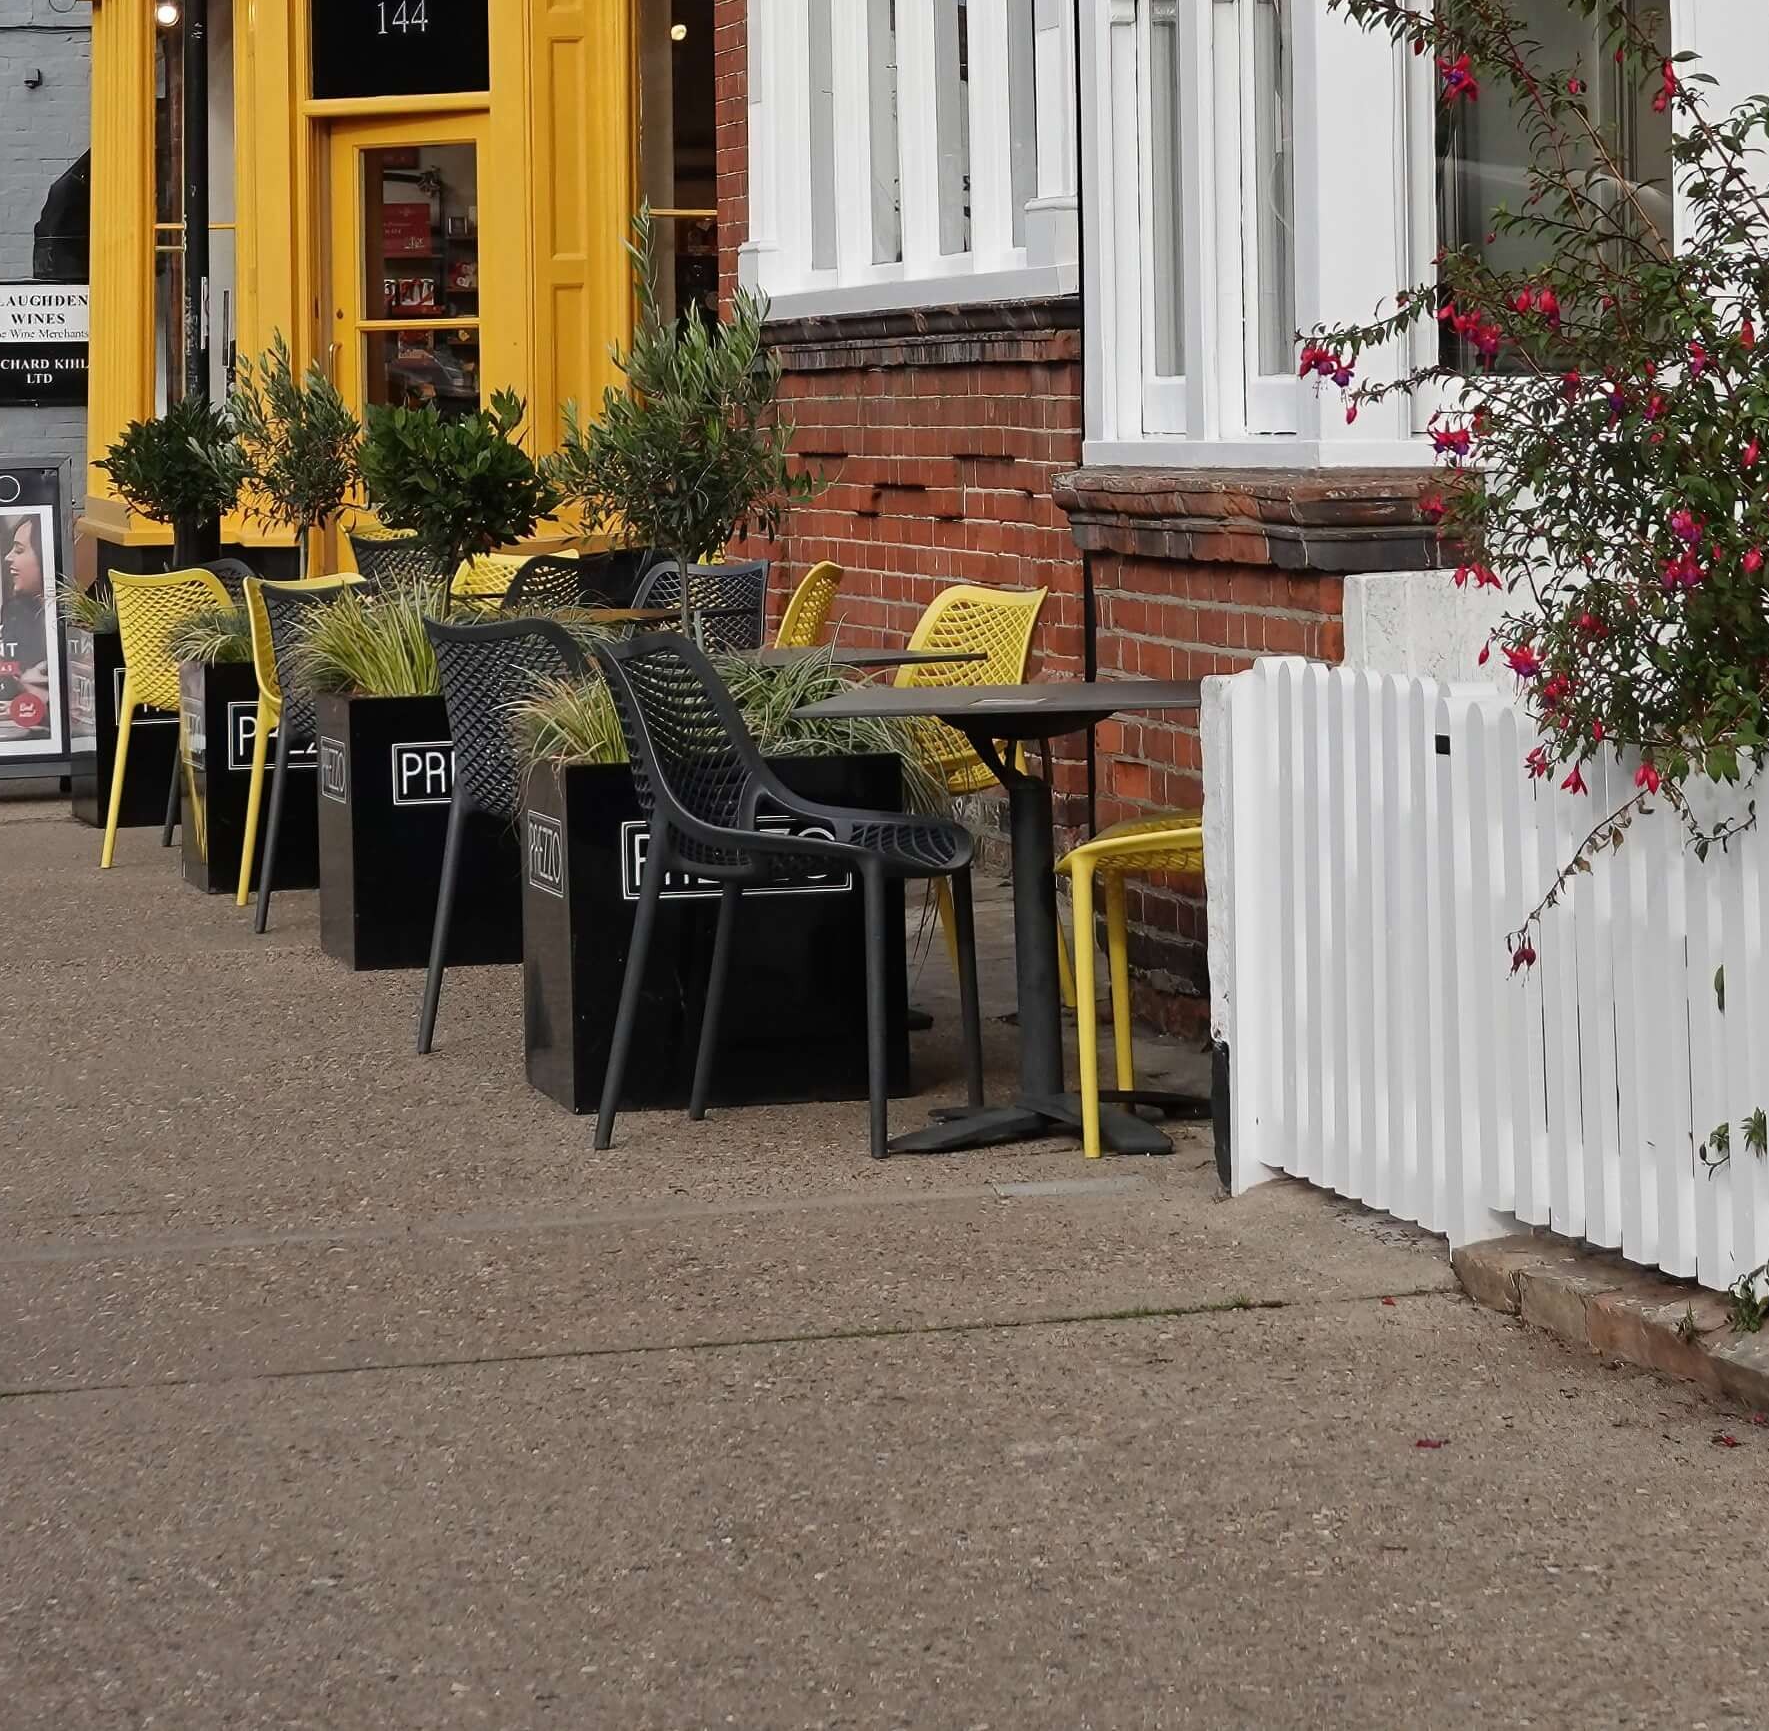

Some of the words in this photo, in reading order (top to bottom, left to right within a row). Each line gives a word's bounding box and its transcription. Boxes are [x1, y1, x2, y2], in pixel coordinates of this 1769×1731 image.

[11, 313, 66, 325] WINES
[10, 329, 35, 339] Wine
[26, 373, 53, 384] LTD
[402, 751, 456, 795] PR
